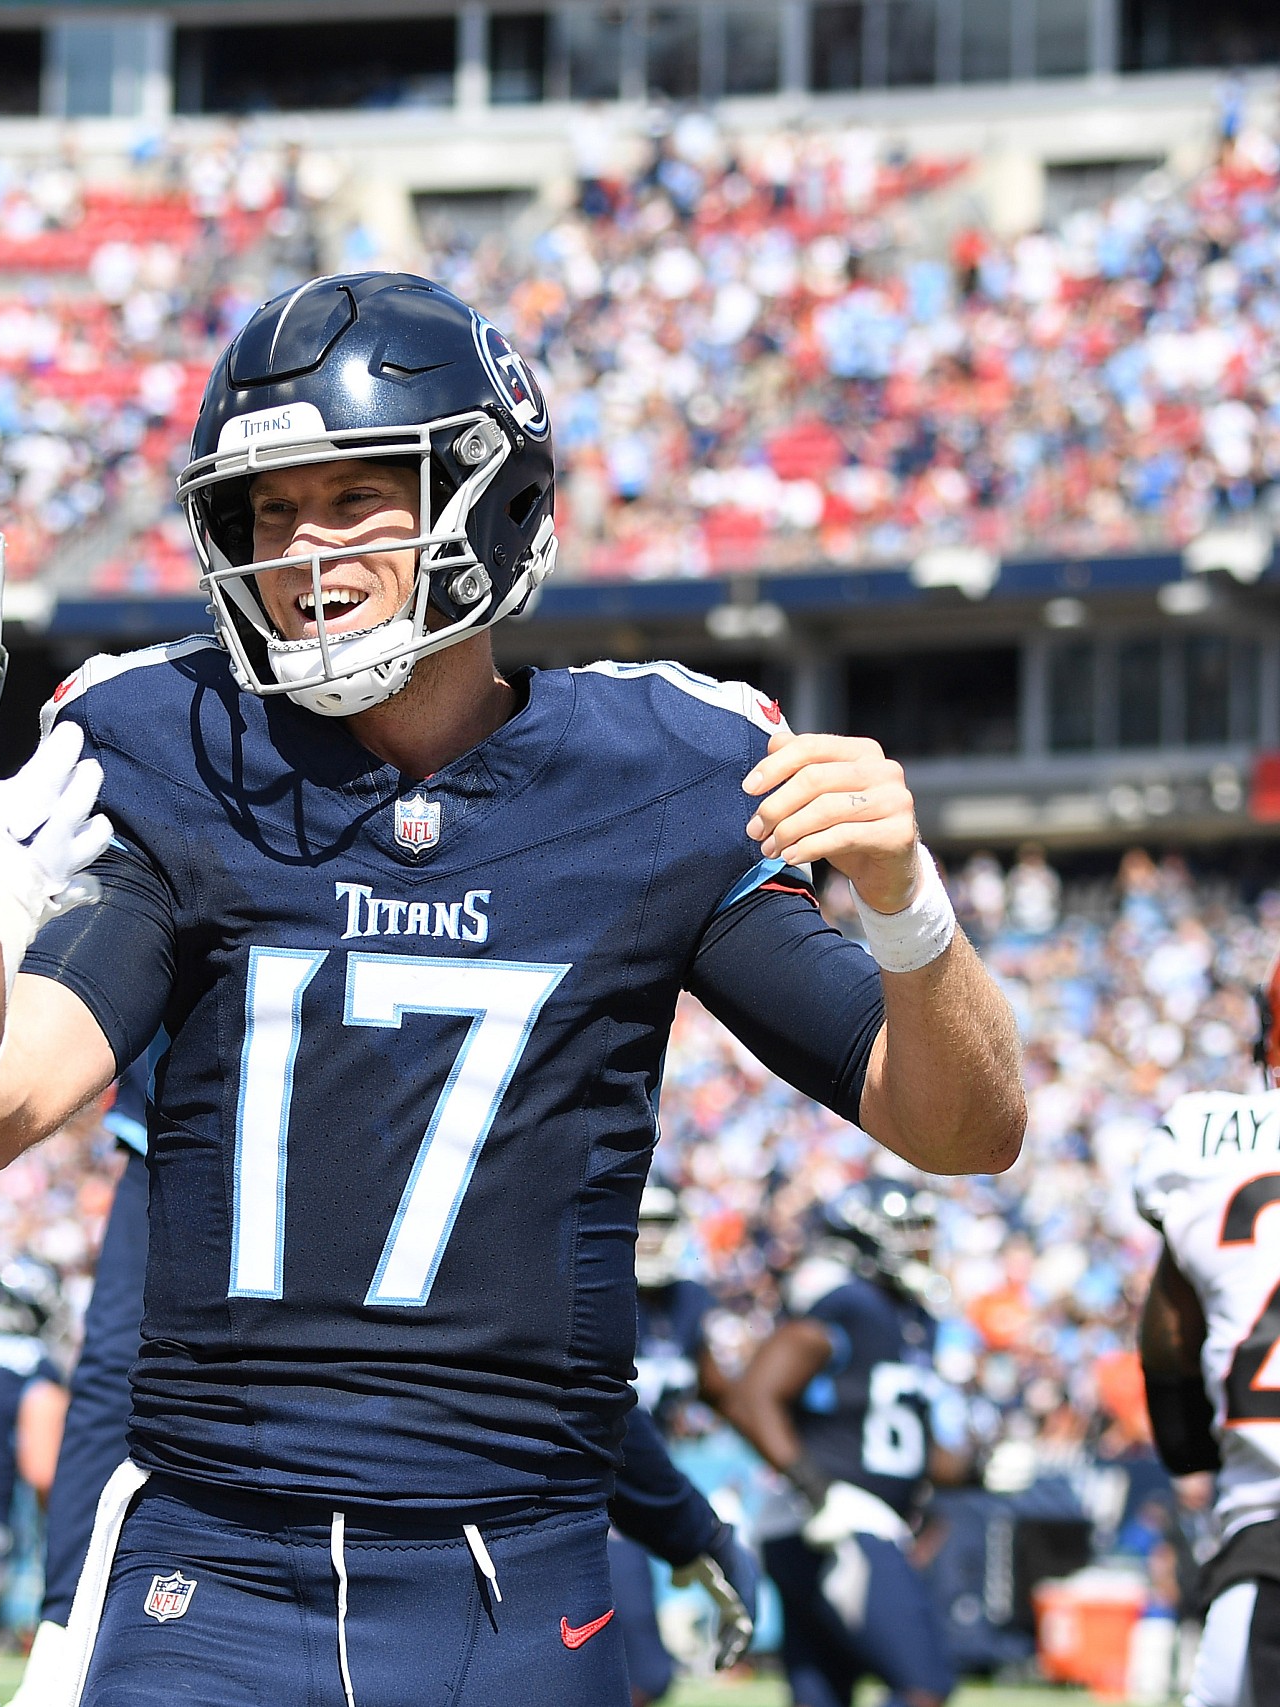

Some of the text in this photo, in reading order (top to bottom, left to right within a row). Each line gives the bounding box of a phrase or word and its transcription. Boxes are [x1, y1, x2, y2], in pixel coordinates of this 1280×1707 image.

[240, 411, 291, 438] TITANS
[401, 821, 432, 843] NFL
[335, 881, 493, 944] TITANS
[225, 945, 574, 1308] 17
[1201, 1109, 1280, 1157] TAY
[151, 1593, 180, 1612] NFL
